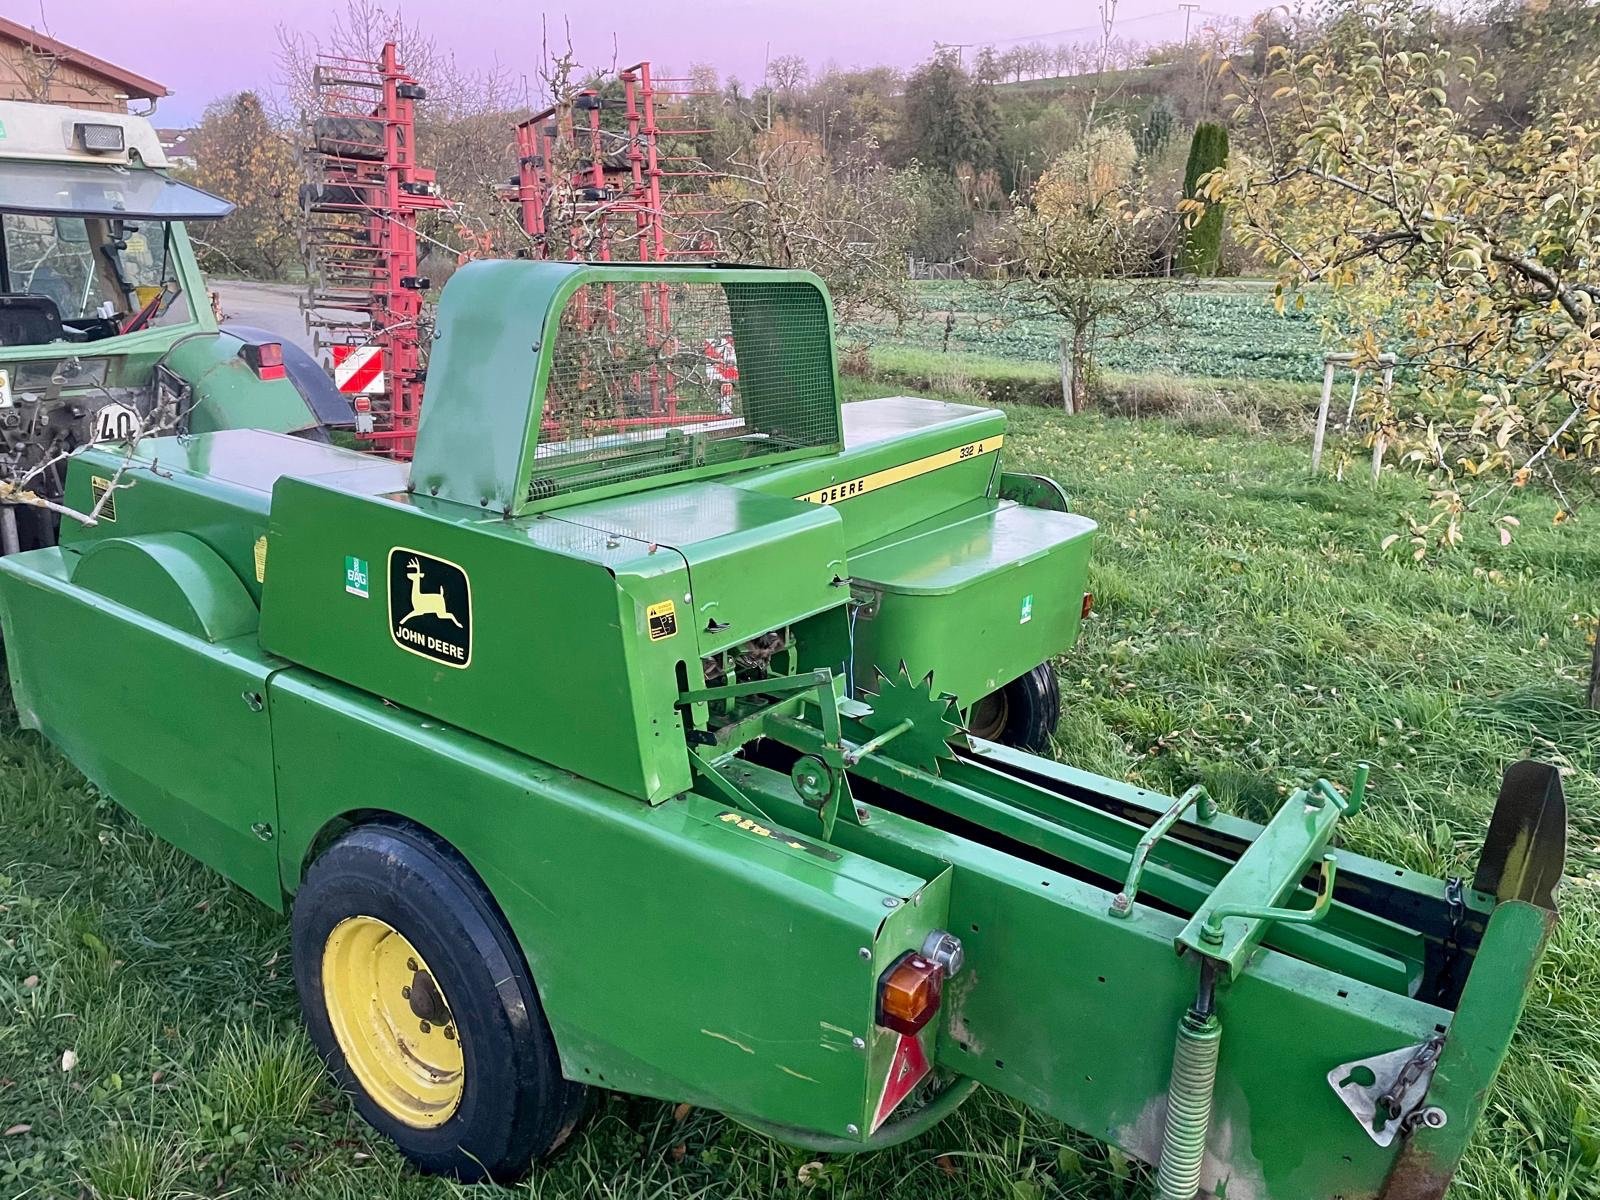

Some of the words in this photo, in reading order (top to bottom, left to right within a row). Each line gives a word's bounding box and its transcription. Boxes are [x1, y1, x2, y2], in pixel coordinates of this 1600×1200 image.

[101, 412, 130, 439] 40
[960, 445, 974, 458] 332
[977, 443, 983, 454] A
[821, 480, 864, 503] DEERE
[396, 626, 426, 646] JOHN
[427, 636, 464, 660] DEERE
